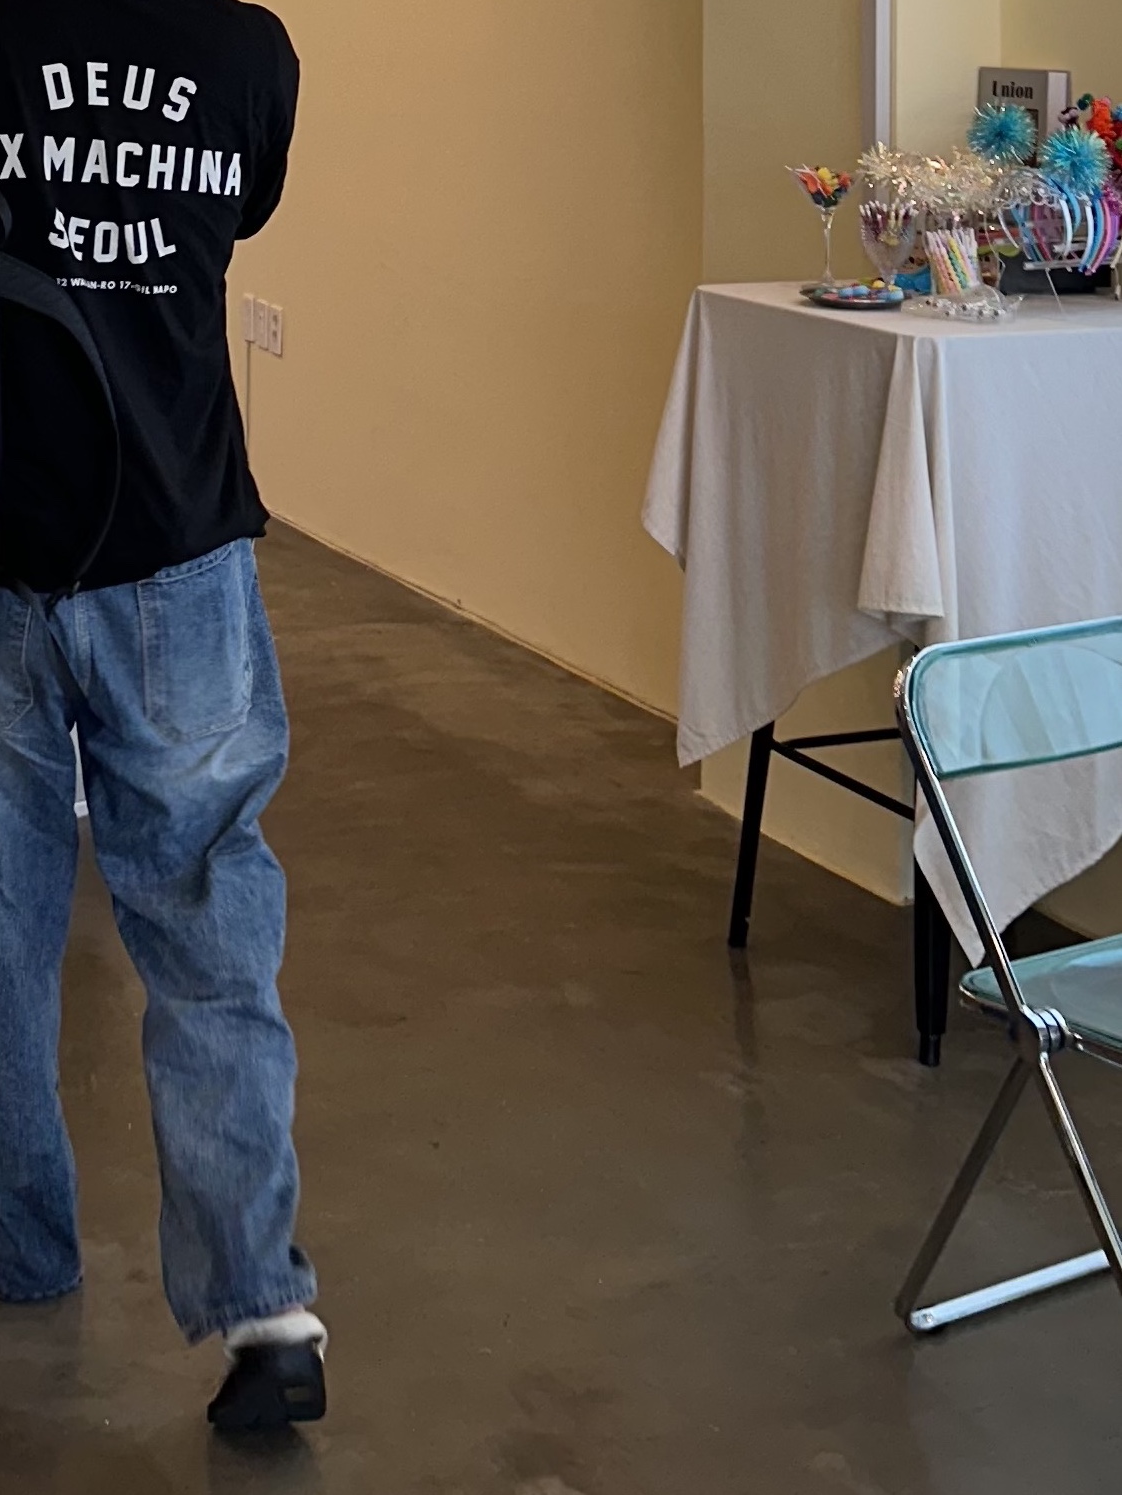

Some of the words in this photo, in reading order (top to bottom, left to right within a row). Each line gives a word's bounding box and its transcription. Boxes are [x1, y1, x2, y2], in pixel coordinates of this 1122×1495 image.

[42, 62, 197, 122] DEUS
[43, 135, 241, 196] MACHINA
[48, 207, 176, 264] SEOUL
